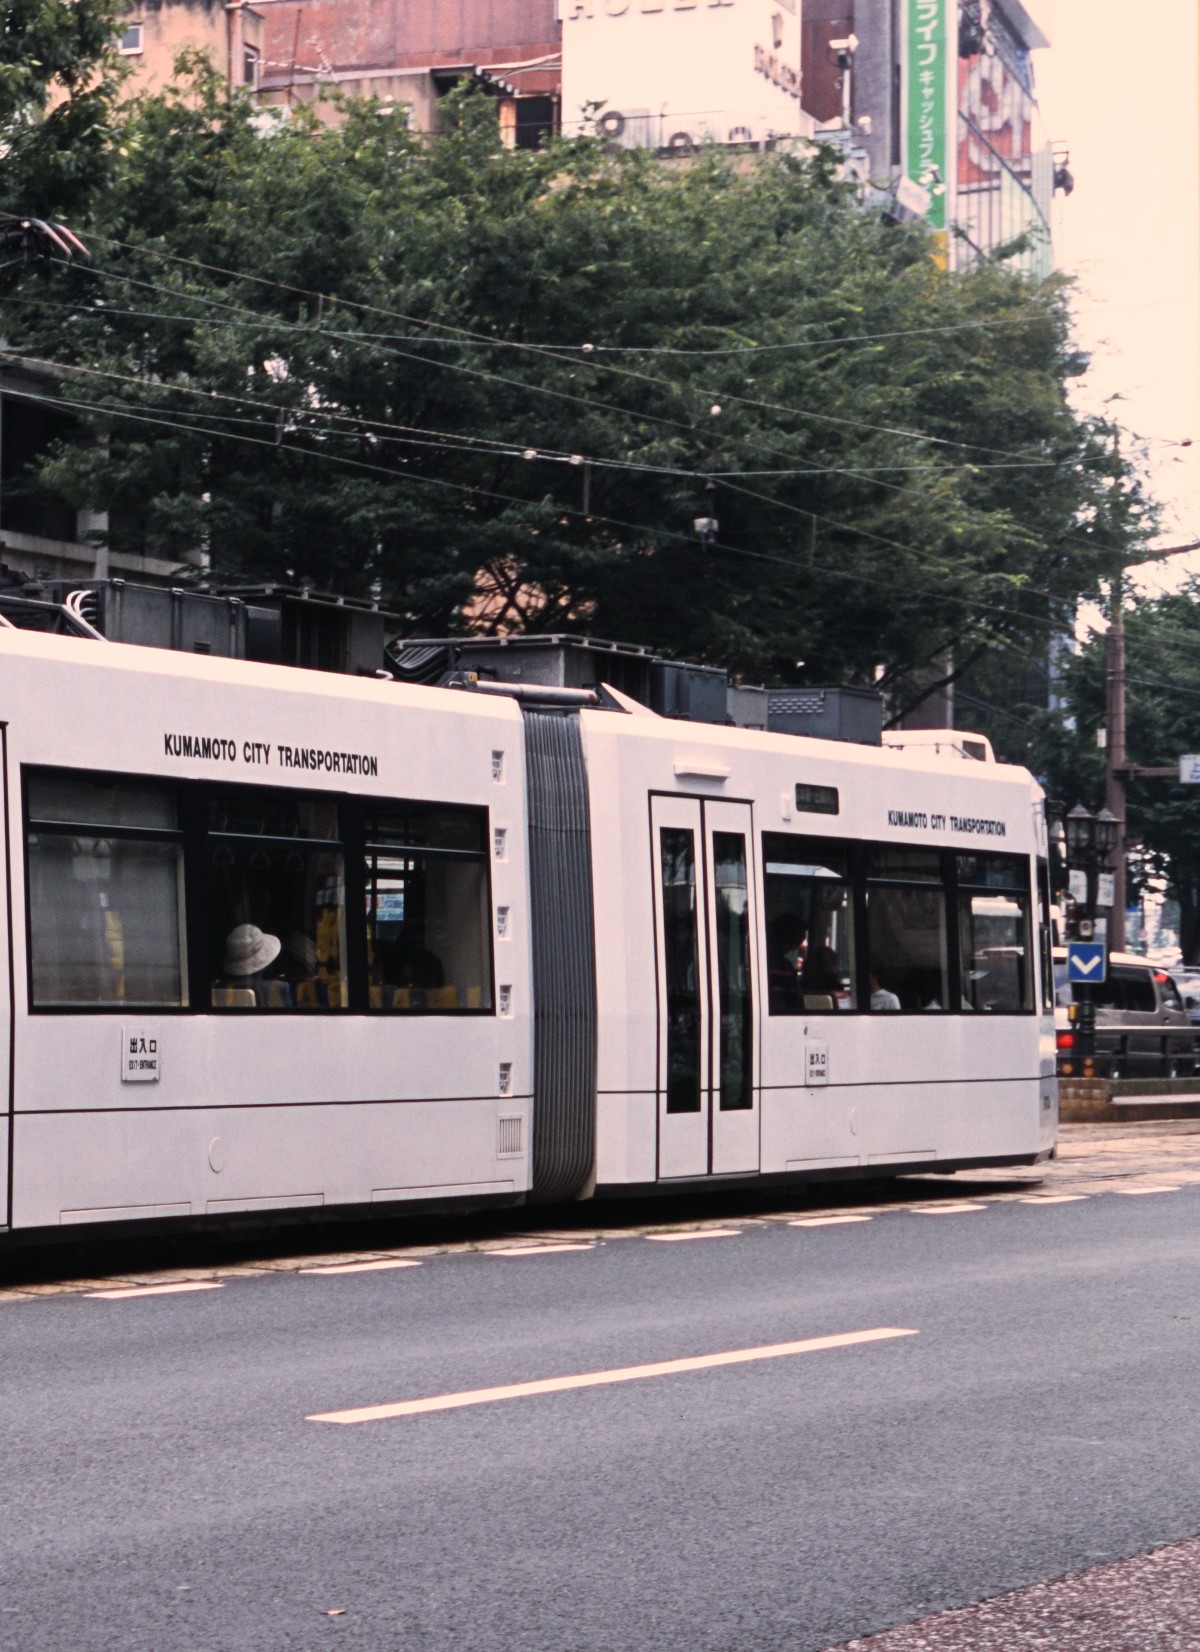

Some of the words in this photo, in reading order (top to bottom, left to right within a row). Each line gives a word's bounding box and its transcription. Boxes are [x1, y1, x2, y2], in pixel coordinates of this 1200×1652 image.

[164, 733, 237, 762] KUMAMOTO
[243, 741, 271, 765] CITY
[277, 745, 378, 777] TRANSPORTATION
[887, 810, 928, 829] KUMAMOTO
[931, 814, 947, 831] CITY
[949, 815, 1007, 837] TRANSPORTATION
[130, 1037, 157, 1053] 出入口
